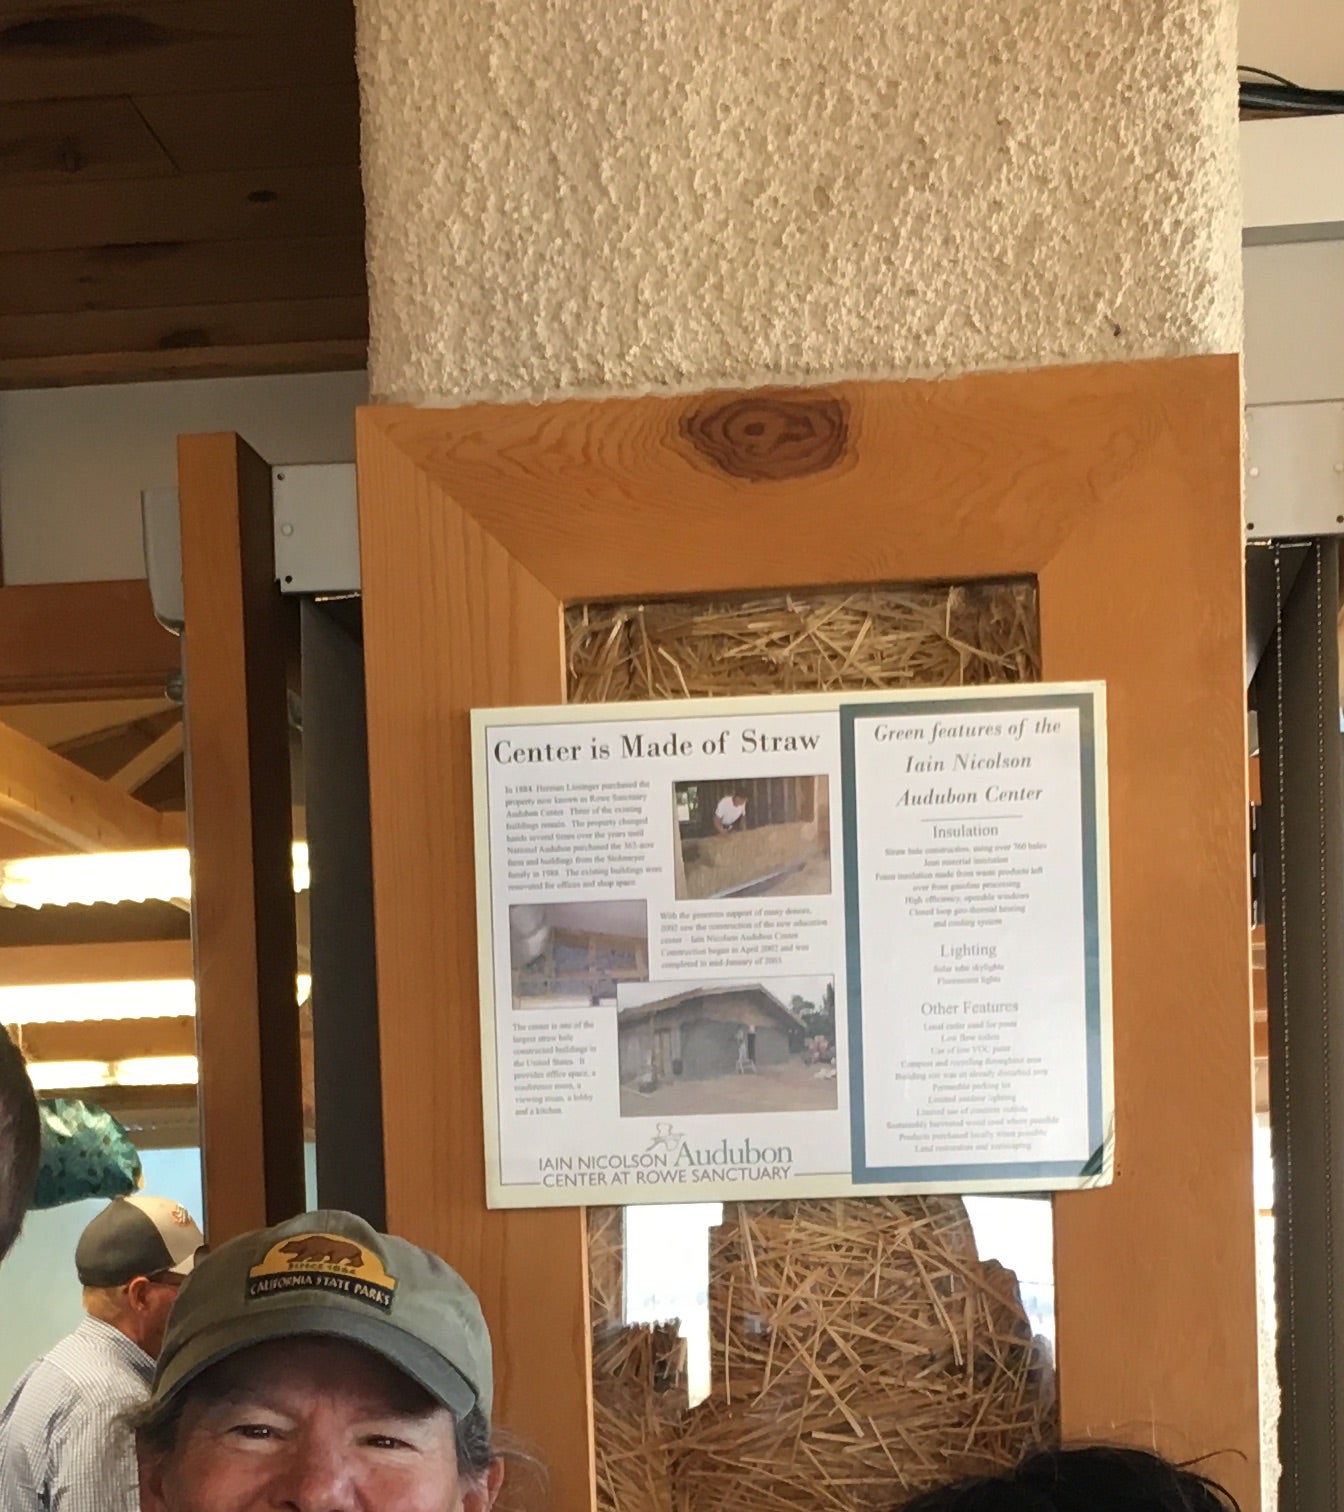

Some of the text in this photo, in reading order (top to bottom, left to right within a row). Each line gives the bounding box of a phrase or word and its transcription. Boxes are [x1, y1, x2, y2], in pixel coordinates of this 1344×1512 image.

[874, 717, 1061, 744] Green features of the
[494, 728, 821, 765] Center is Made of Straw
[906, 752, 1032, 774] Iain Nicolson
[896, 784, 1043, 807] Audubon Center
[933, 824, 999, 839] Insulation
[940, 943, 997, 960] Lighting
[921, 1001, 1019, 1016] Other Features
[539, 1138, 793, 1171] IAIN NICOLSON Audubon
[543, 1166, 791, 1188] CENTER AT ROWE SANCTUARY
[250, 1276, 390, 1306] CALIFORNIA STATE PARKS
